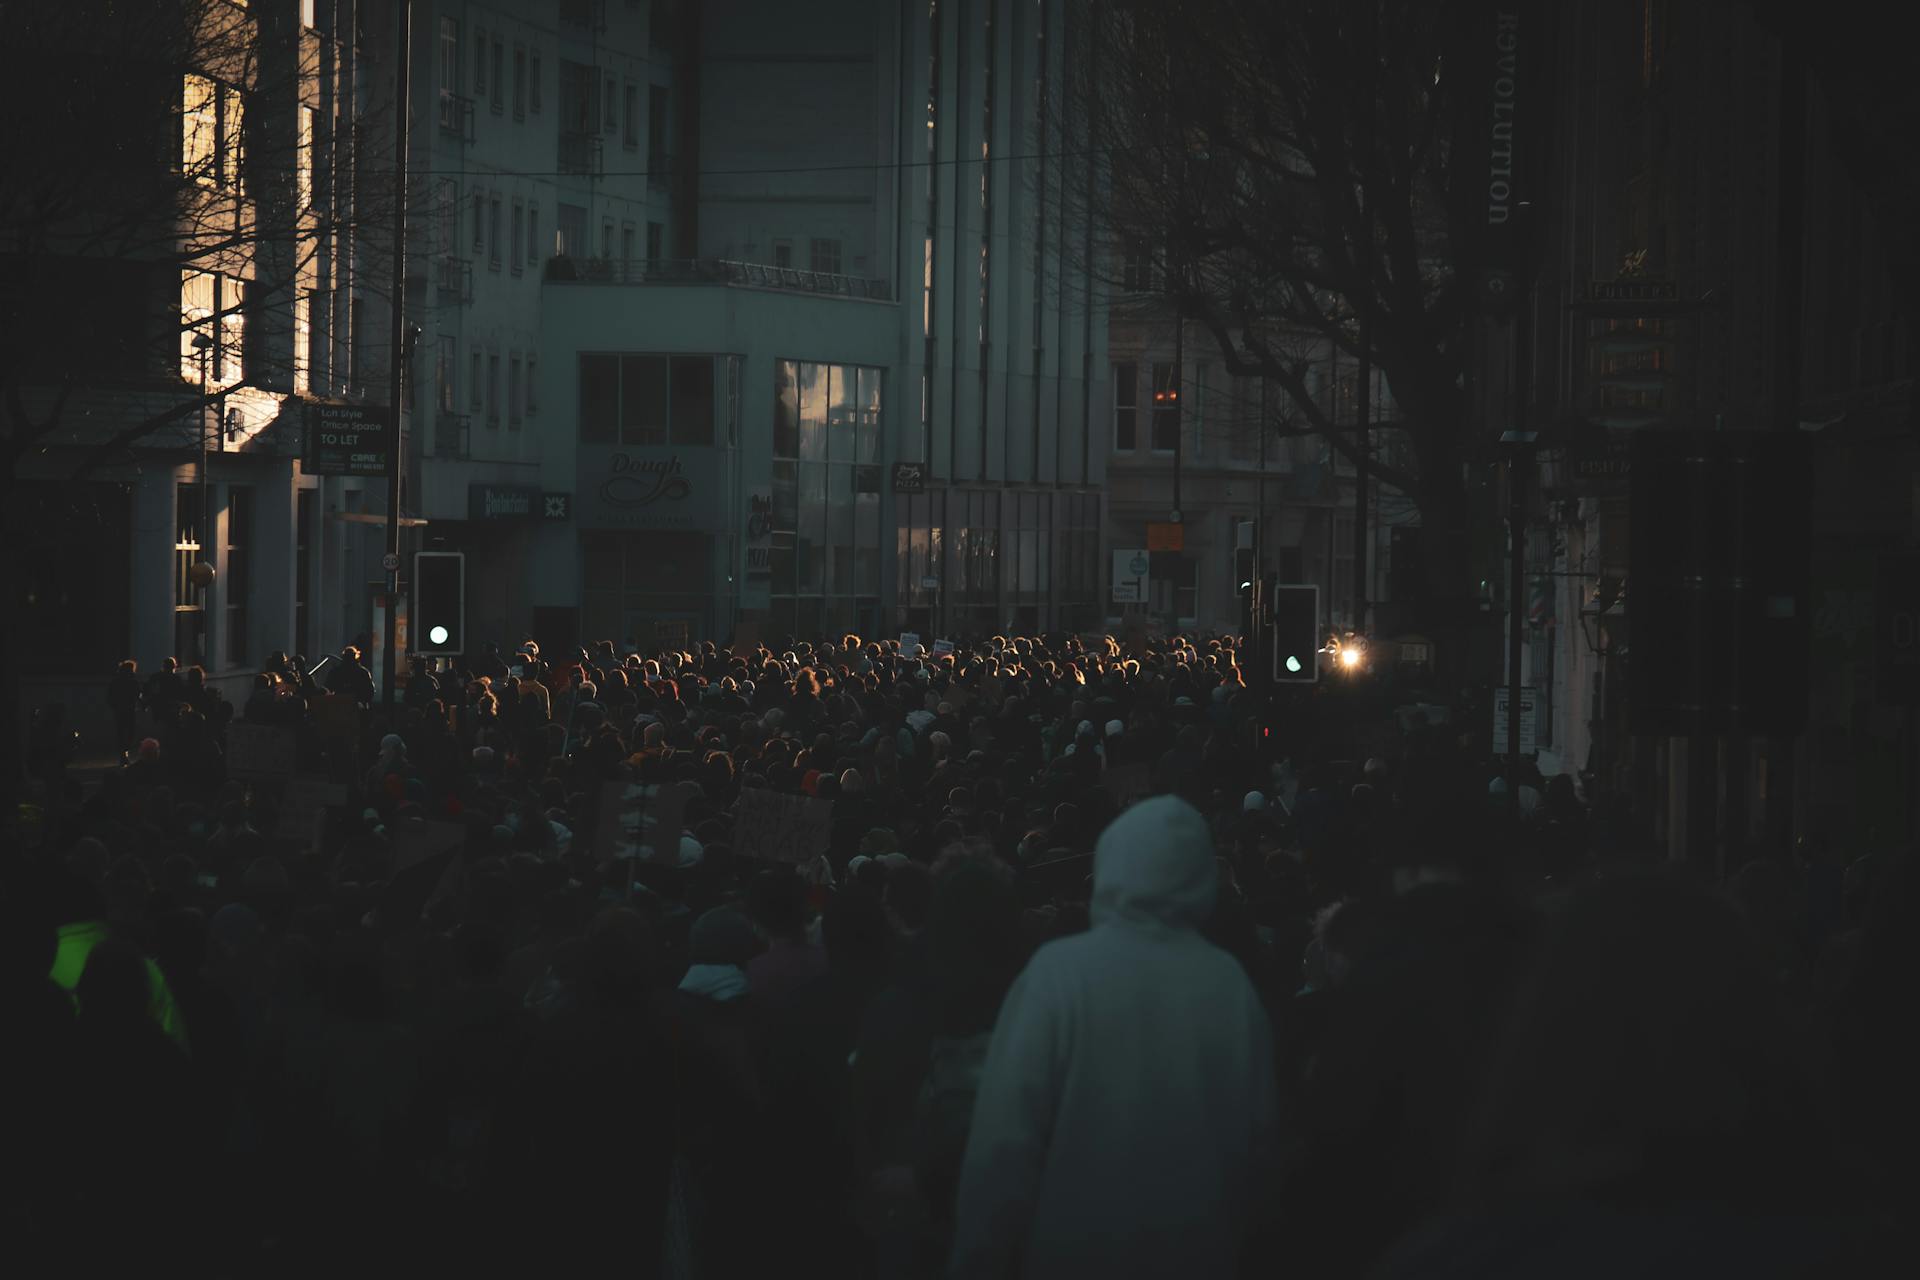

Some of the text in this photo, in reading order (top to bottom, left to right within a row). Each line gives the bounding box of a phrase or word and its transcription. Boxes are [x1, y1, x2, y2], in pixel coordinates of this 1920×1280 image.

[351, 422, 383, 433] Space
[320, 434, 360, 445] TO LET
